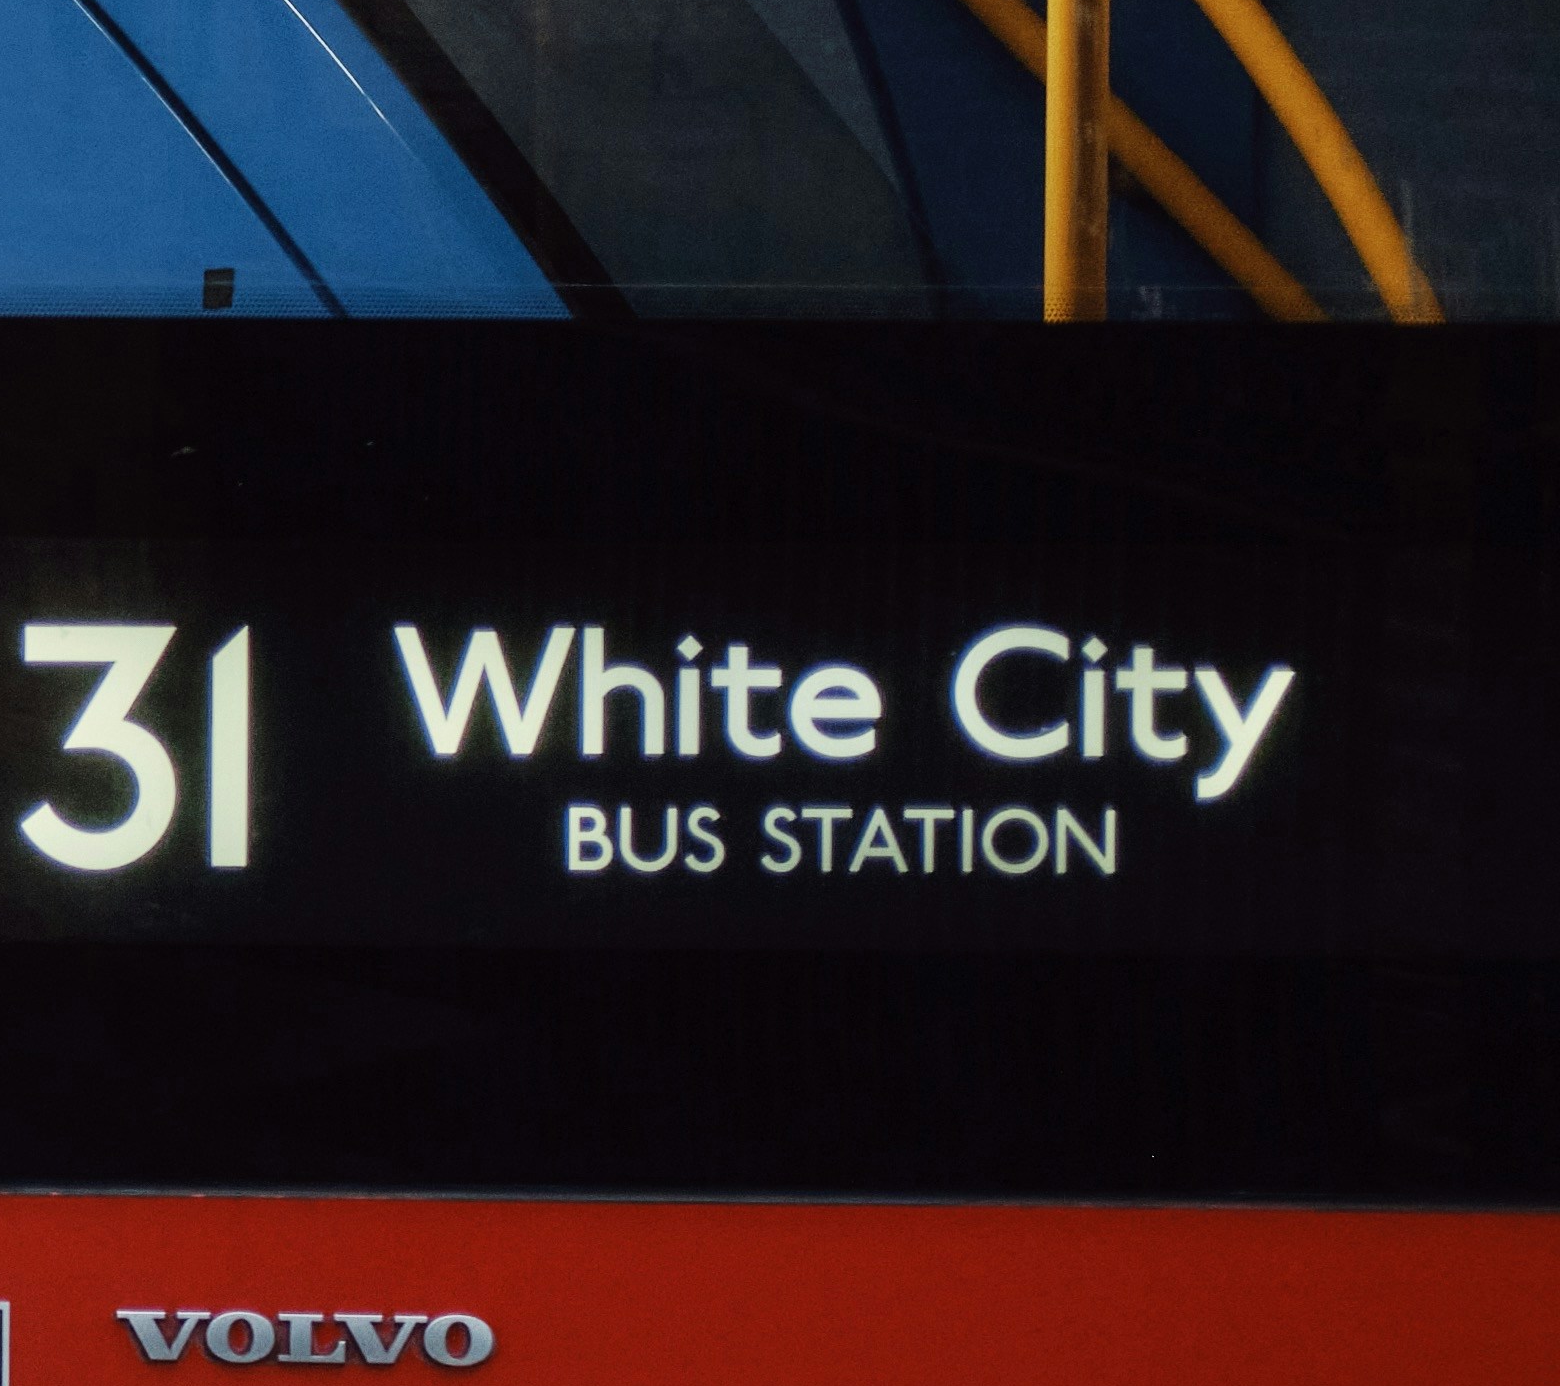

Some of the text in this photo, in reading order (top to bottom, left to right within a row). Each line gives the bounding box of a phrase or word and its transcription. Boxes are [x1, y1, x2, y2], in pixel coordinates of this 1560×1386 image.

[20, 621, 1298, 873] 31 White City
[566, 804, 1117, 875] BUS STATION
[115, 1308, 495, 1367] VOLVO
